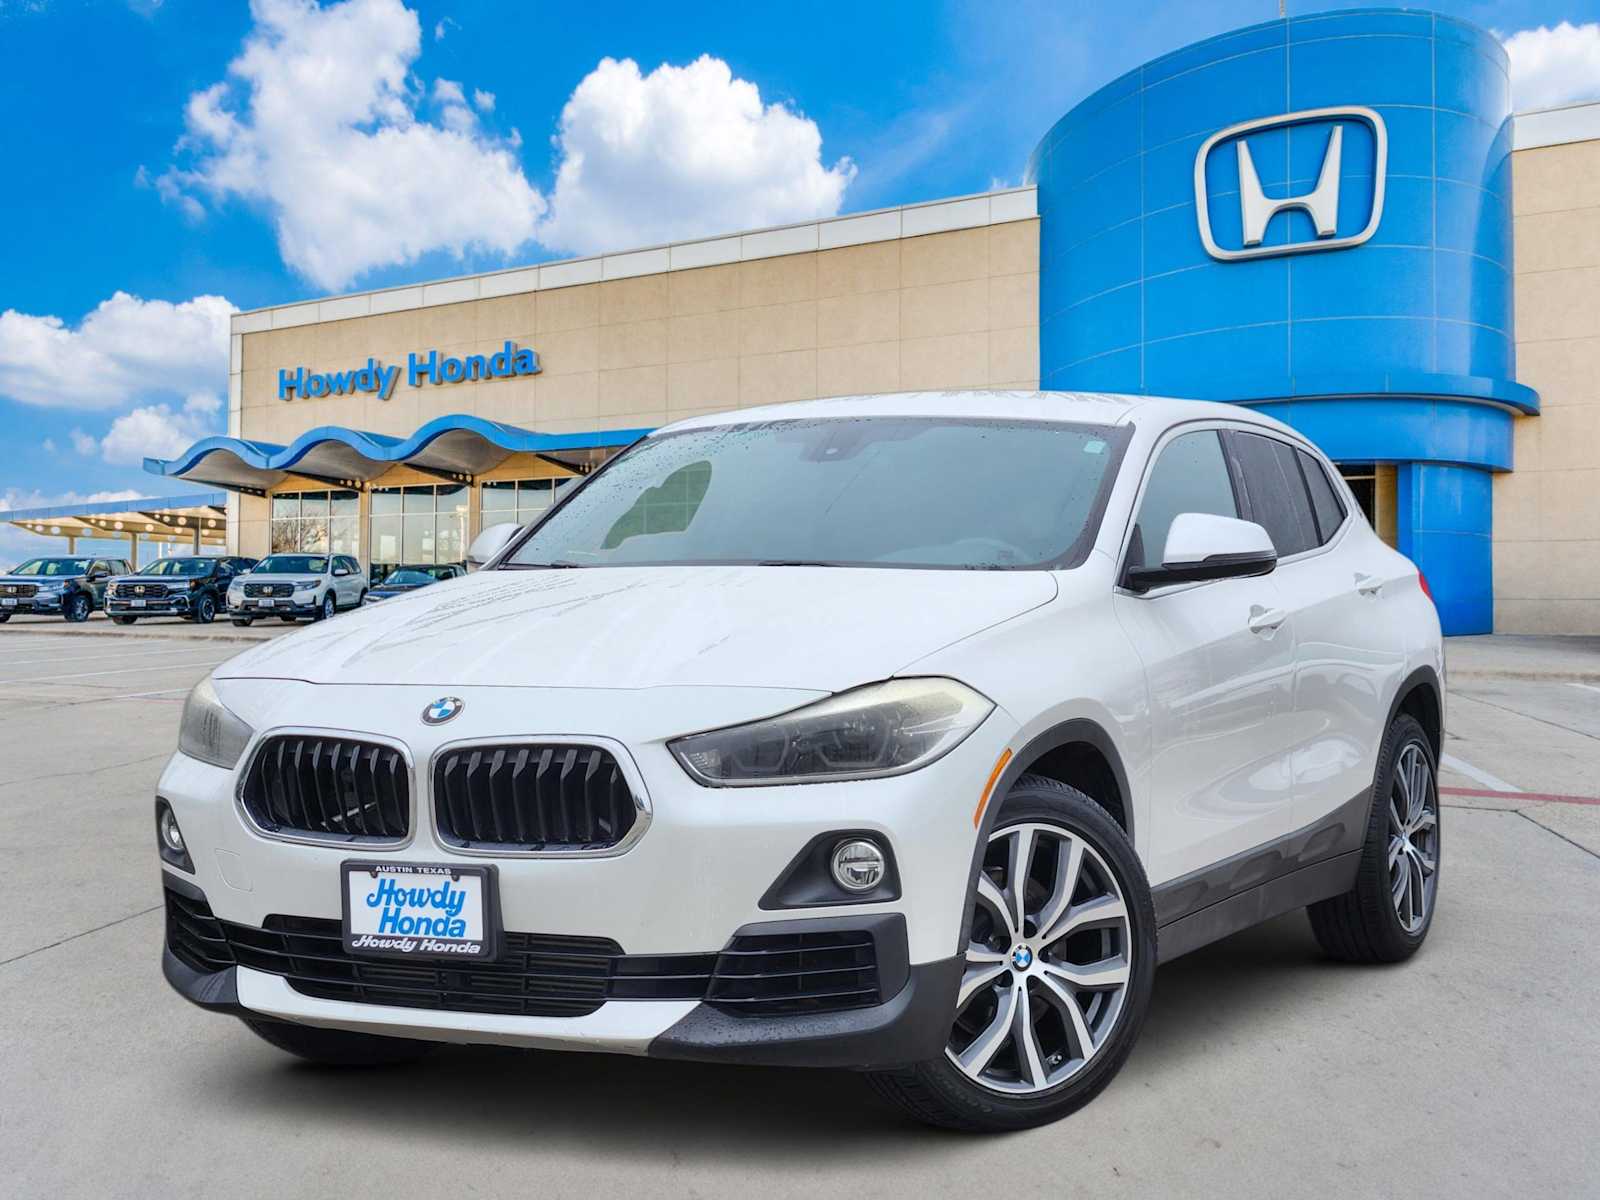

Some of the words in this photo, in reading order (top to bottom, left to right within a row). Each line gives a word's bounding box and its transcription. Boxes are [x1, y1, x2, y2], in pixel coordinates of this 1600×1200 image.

[279, 358, 401, 401] Howdy
[408, 341, 541, 387] Honda
[375, 865, 413, 873] AUSTIN
[416, 867, 452, 875] TEXAS
[366, 878, 466, 917] Howdy
[378, 907, 467, 938] Honda
[351, 935, 417, 953] Howdy
[419, 939, 481, 954] Honda
